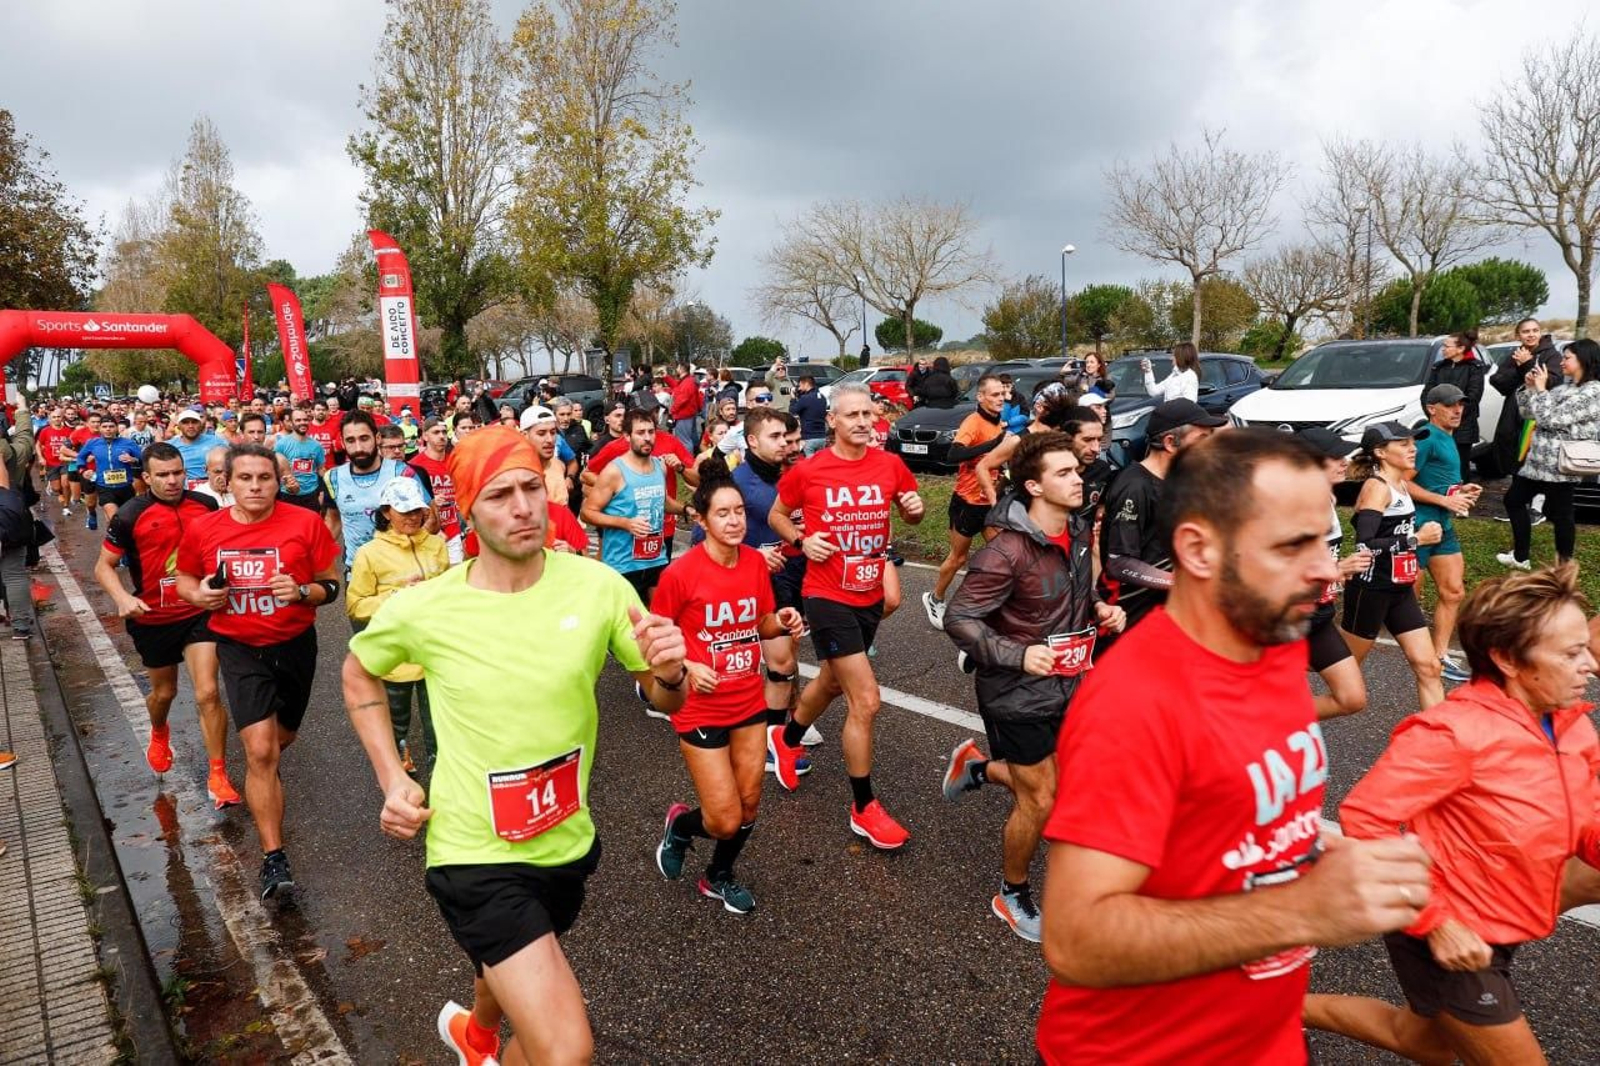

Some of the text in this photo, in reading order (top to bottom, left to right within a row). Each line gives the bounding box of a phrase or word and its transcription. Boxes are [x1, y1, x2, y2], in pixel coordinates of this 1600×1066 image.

[37, 319, 168, 334] Sports Santander
[826, 485, 885, 508] LA 21
[829, 523, 855, 532] media
[642, 540, 658, 553] 105
[836, 531, 885, 555] Vigo
[232, 560, 265, 577] 502
[856, 564, 880, 581] 395
[705, 597, 757, 627] LA 21
[725, 650, 752, 671] 263
[1060, 644, 1087, 665] 230
[1246, 721, 1329, 826] LA 21
[526, 779, 557, 817] 14
